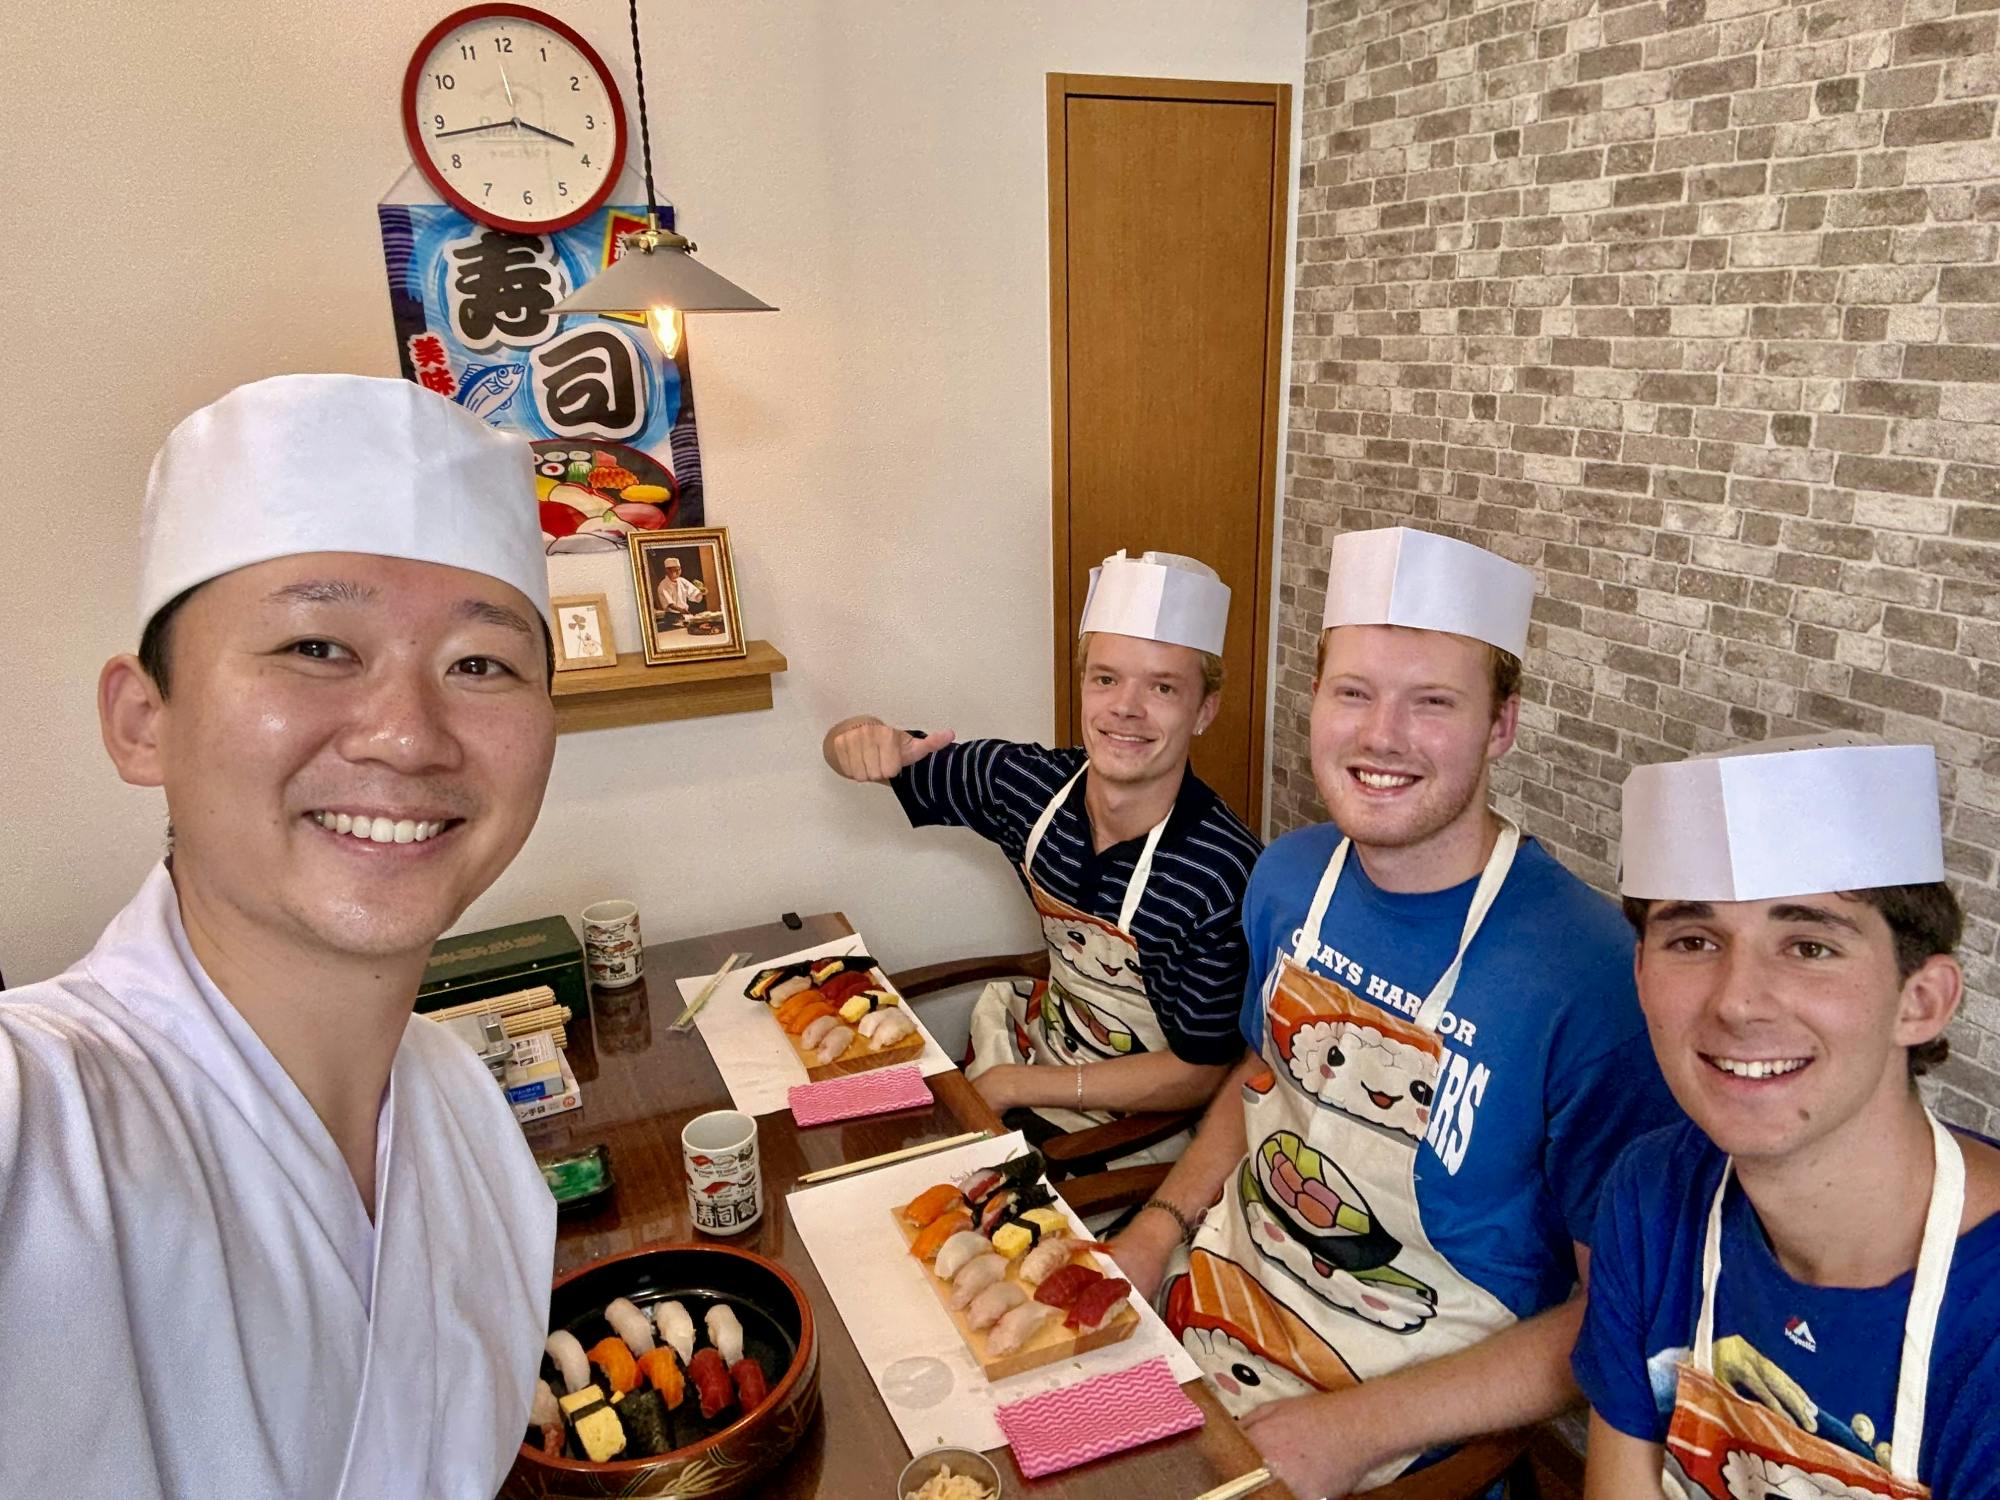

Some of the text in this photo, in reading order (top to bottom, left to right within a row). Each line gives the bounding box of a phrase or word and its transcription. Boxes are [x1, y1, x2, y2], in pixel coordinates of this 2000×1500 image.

[460, 45, 476, 61] 11
[494, 37, 513, 53] 12
[540, 47, 547, 62] 1
[435, 74, 456, 90] 10
[569, 76, 581, 92] 2
[434, 114, 445, 130] 9
[585, 115, 595, 130] 3
[451, 153, 462, 169] 8
[580, 153, 591, 168] 4
[484, 182, 493, 197] 7
[558, 182, 568, 196] 5
[522, 190, 533, 205] 6
[452, 230, 638, 429] 寿司
[1365, 974, 1477, 1047] HAROR
